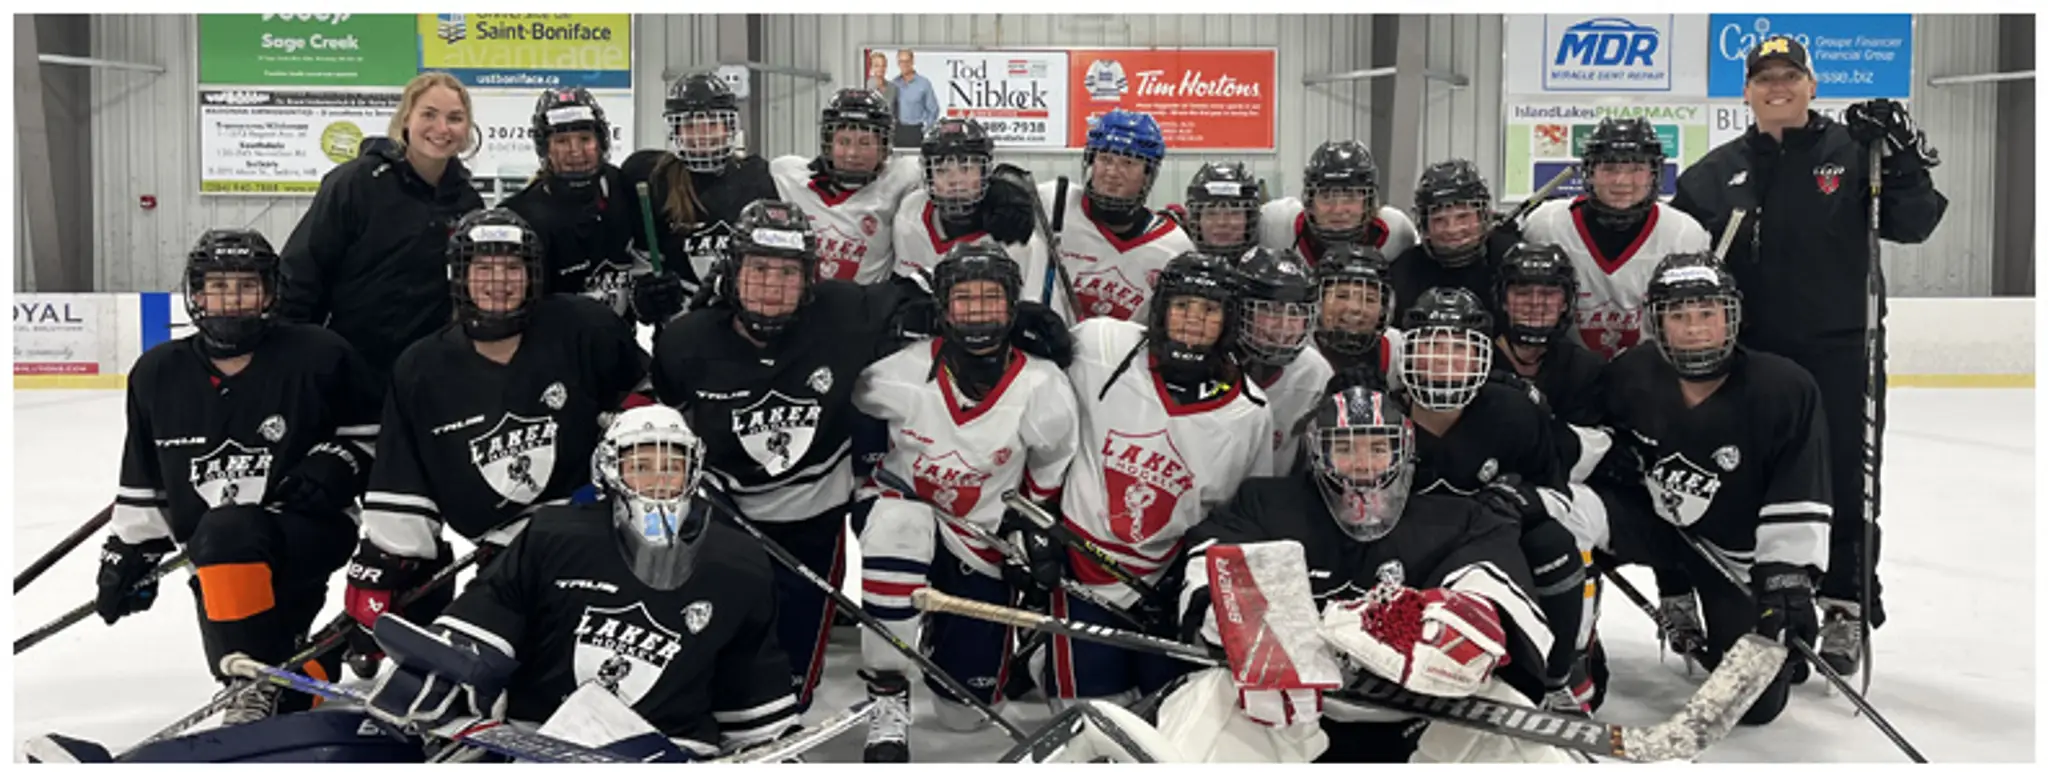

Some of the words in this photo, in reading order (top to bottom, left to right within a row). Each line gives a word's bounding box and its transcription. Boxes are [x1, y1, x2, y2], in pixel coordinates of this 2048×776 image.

[261, 33, 305, 52] Sage
[310, 34, 359, 49] Creek
[476, 21, 611, 40] Saint-Boniface
[1719, 18, 1810, 60] Caie
[1815, 36, 1851, 49] Groupe
[1855, 36, 1902, 46] Financier
[445, 42, 623, 78] avantage
[1555, 33, 1659, 66] MDR
[1815, 50, 1860, 60] Financial
[1864, 50, 1895, 61] Group
[476, 74, 560, 85] ustboniface.ca
[946, 60, 987, 79] Tod
[1136, 70, 1176, 96] Tim
[1178, 69, 1261, 97] Hortons
[1551, 71, 1595, 80] MIRACLE
[1597, 72, 1624, 80] DENT
[1627, 72, 1665, 80] REPAIR
[948, 80, 1048, 109] Niblock
[683, 235, 729, 252] LAK
[1073, 277, 1145, 307] LAKER
[732, 406, 822, 433] LAKER
[470, 421, 559, 464] LAKER
[1102, 437, 1194, 491] LAKER
[1652, 466, 1722, 493] AKER
[574, 614, 682, 661] LAKER
